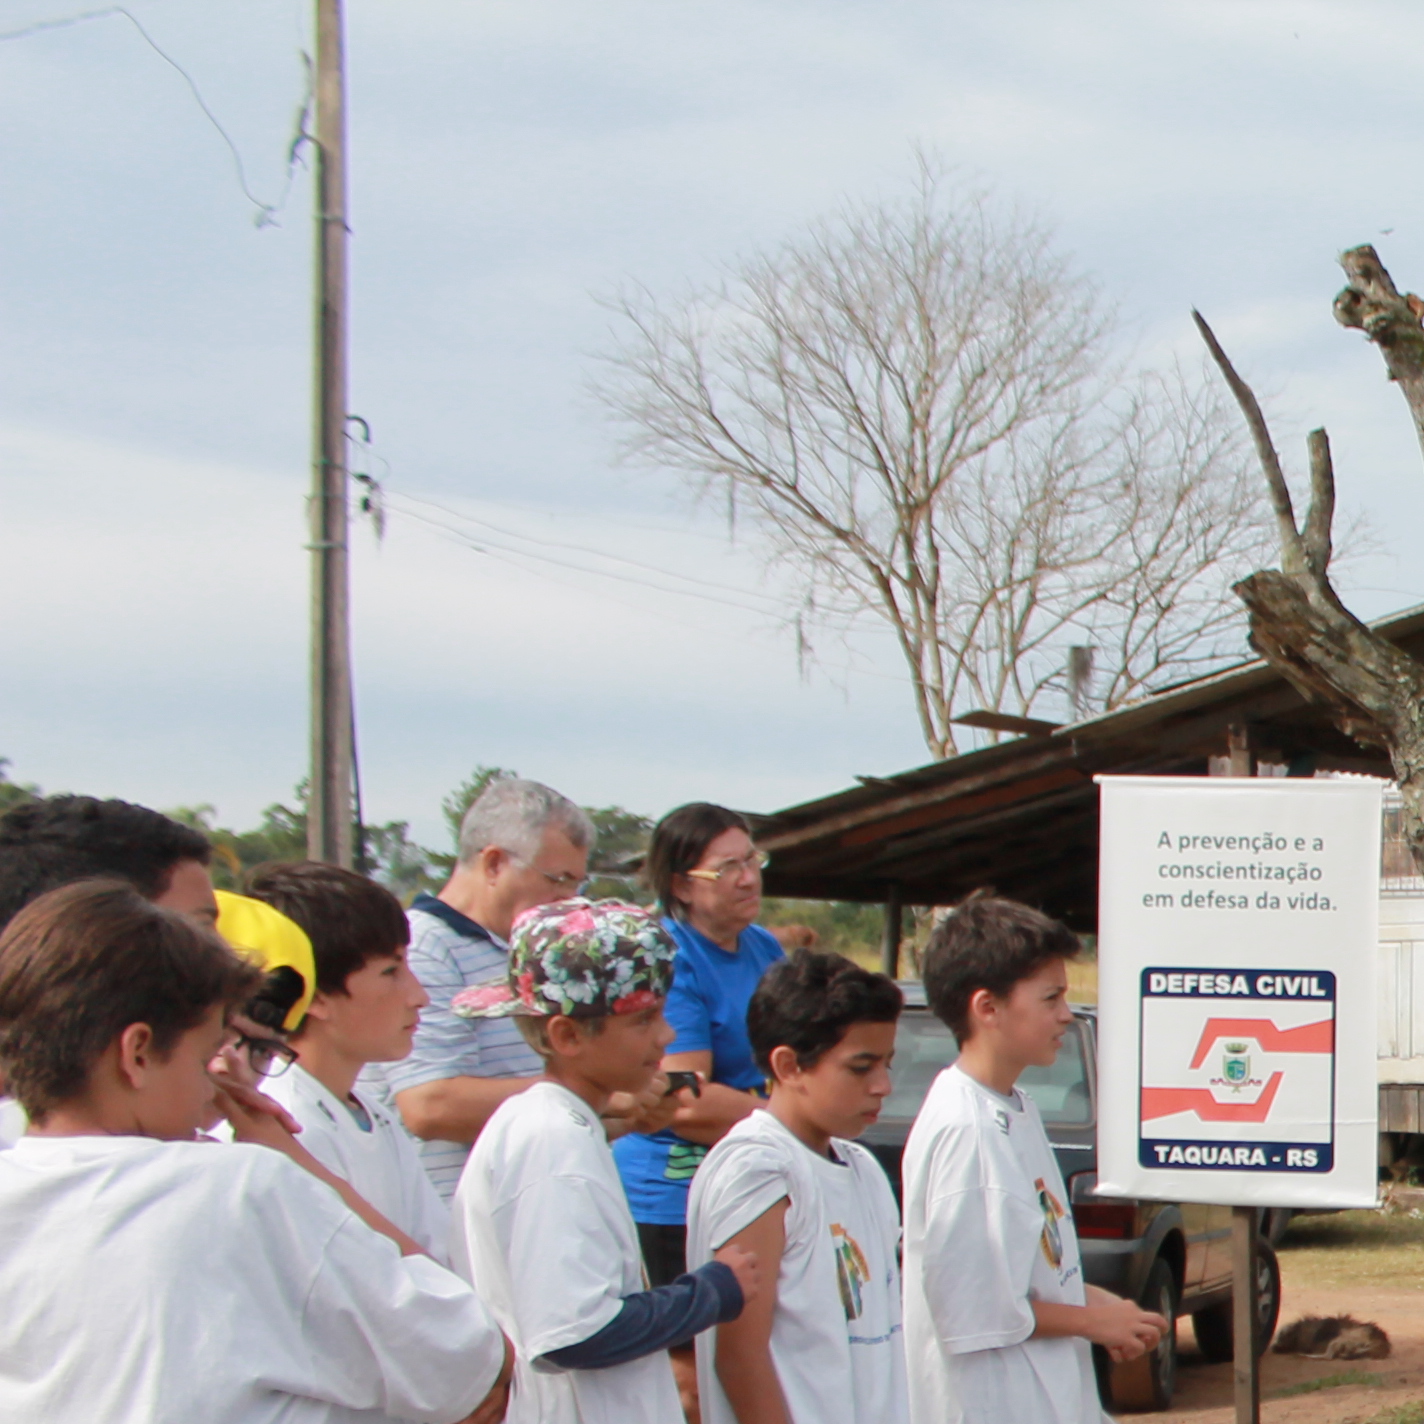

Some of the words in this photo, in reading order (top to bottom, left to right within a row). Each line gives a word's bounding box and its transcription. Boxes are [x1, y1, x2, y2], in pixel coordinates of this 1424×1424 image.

[1157, 831, 1172, 849] A
[1178, 832, 1288, 854] prevenção
[1294, 836, 1306, 851] e
[1312, 837, 1324, 851] a
[1158, 861, 1322, 885] conscientização
[1142, 893, 1174, 908] em
[1180, 889, 1249, 909] defesa
[1256, 891, 1281, 910] da
[1287, 892, 1338, 912] vida.
[1149, 973, 1250, 995] DEFESA
[1256, 975, 1326, 997] CIVIL
[1154, 1144, 1267, 1166] TAQUARA
[1286, 1149, 1318, 1167] RS
